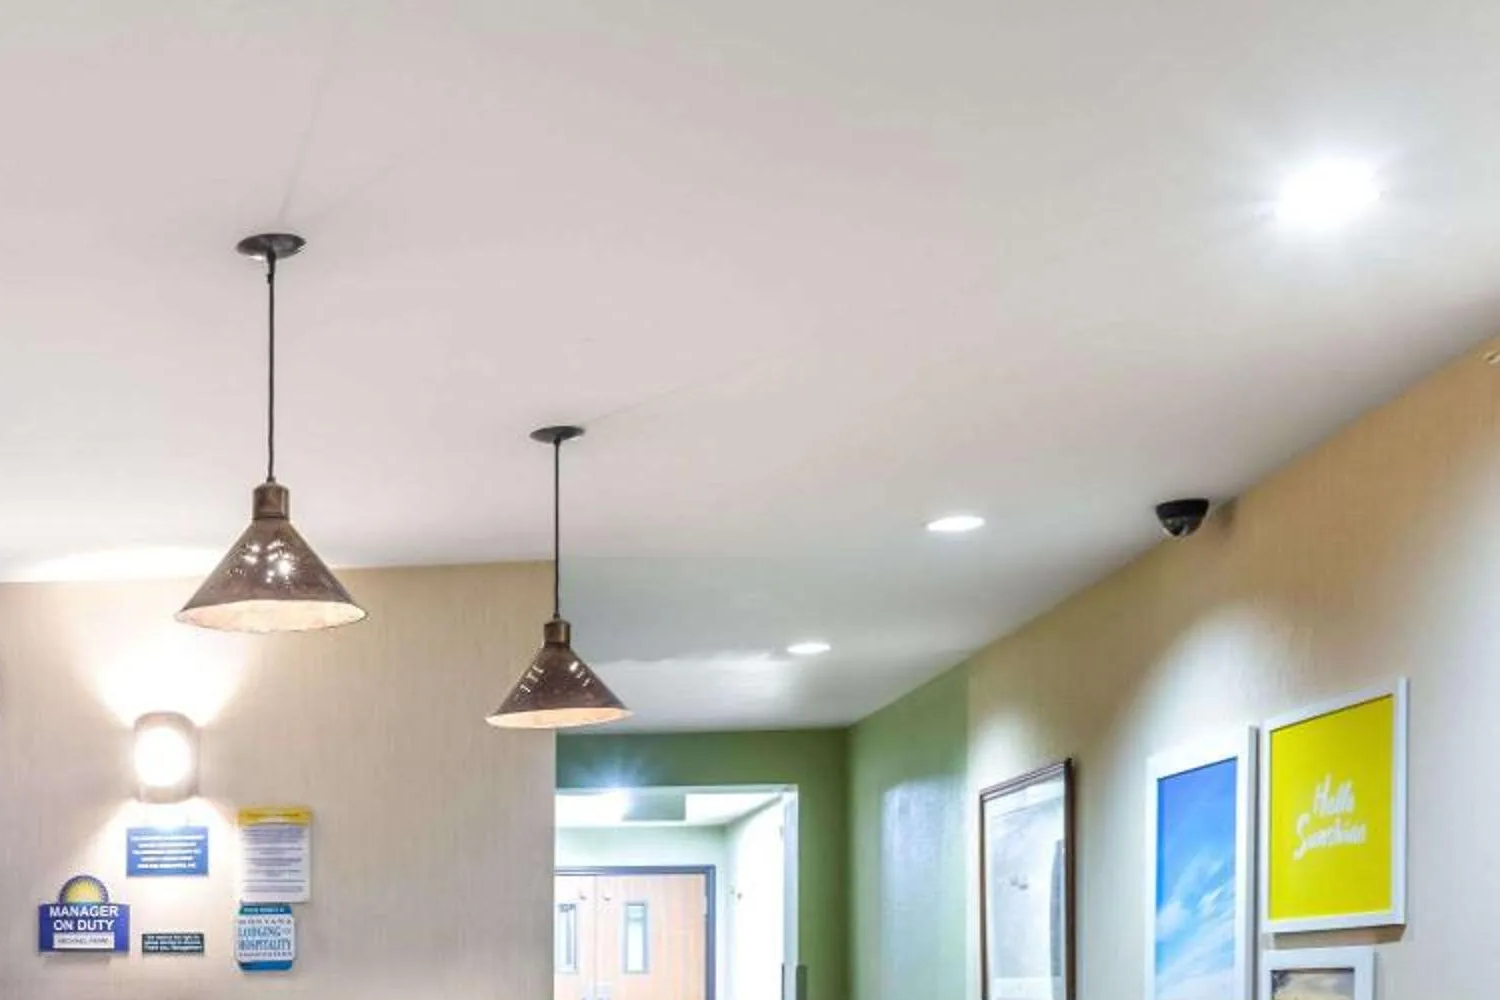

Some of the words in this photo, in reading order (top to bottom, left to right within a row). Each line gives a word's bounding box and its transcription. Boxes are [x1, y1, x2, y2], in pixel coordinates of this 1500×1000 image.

[49, 905, 119, 918] MANAGER
[53, 919, 74, 931] ON
[77, 919, 115, 931] DUTY
